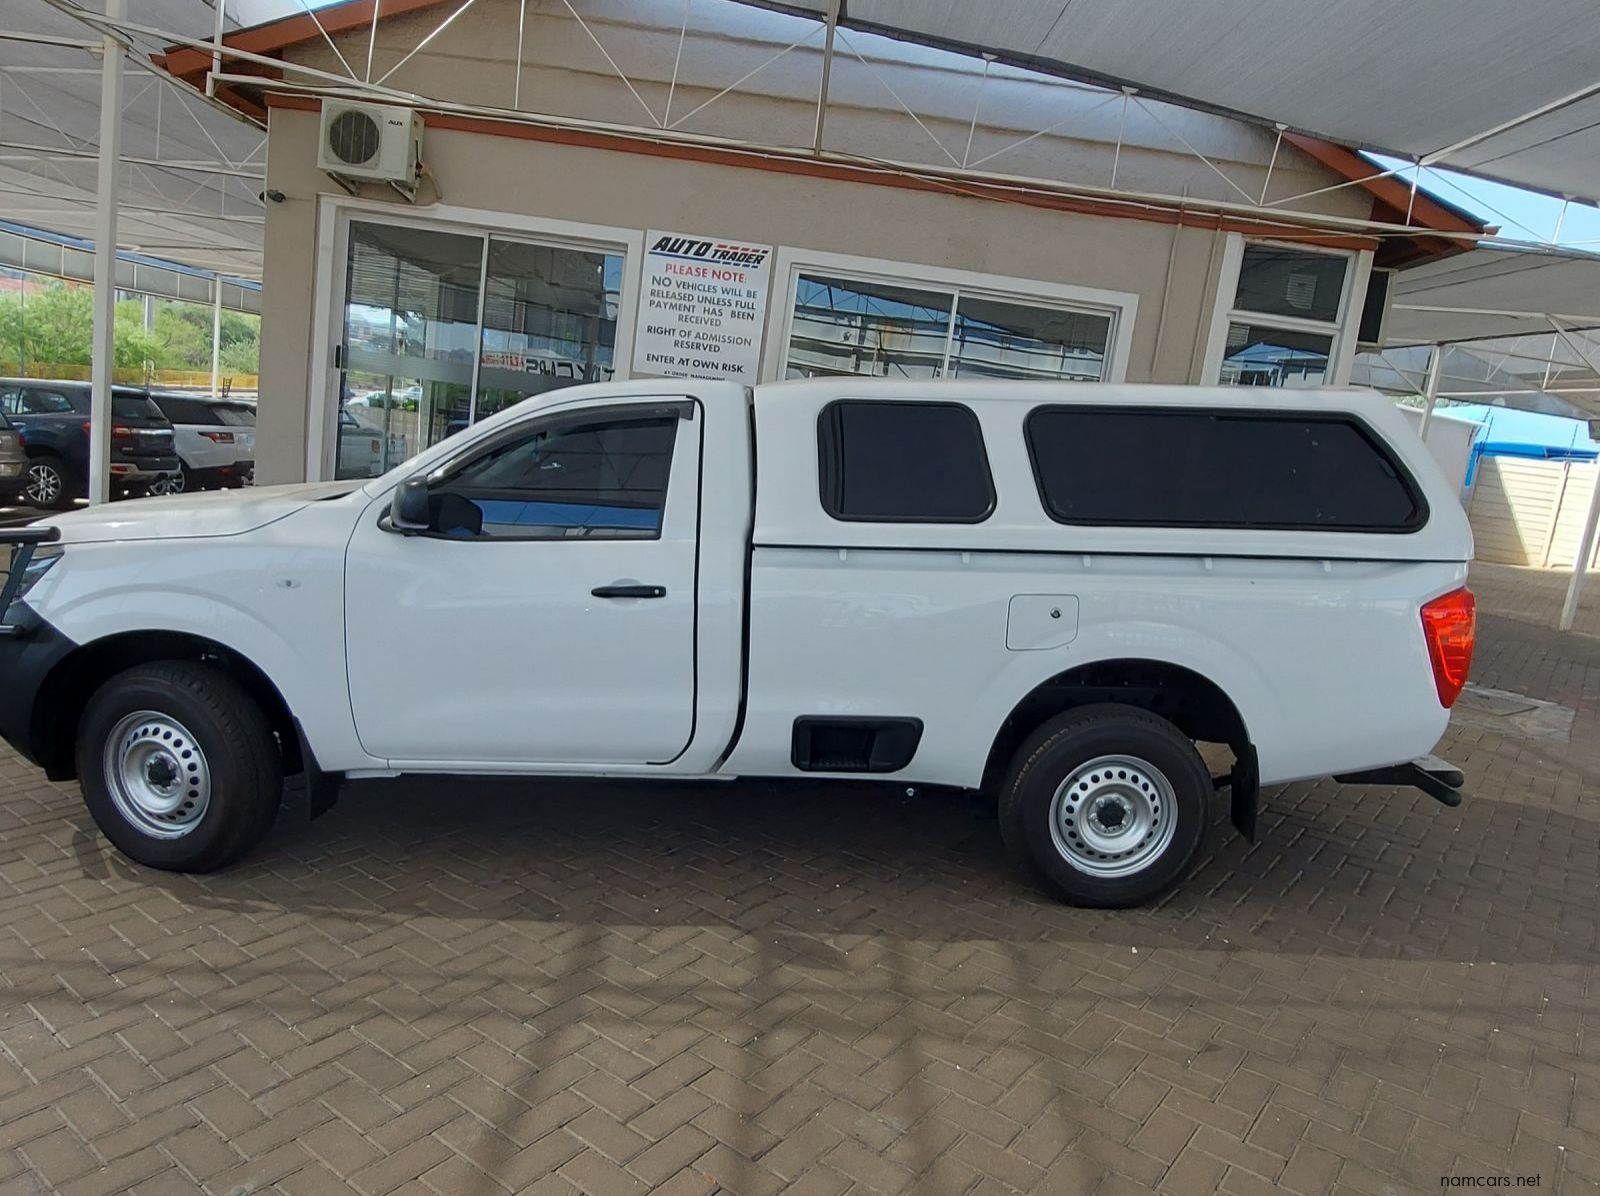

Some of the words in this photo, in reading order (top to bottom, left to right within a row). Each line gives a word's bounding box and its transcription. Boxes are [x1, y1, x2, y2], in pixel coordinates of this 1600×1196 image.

[652, 236, 713, 257] AUTO
[711, 249, 764, 265] TRADER
[665, 263, 708, 278] PLEASE
[651, 275, 672, 287] NO
[676, 279, 718, 294] VEHICLES
[721, 286, 743, 297] WILL
[746, 289, 758, 299] BE
[650, 289, 694, 302] RELEASED
[697, 295, 733, 307] UNLESS
[735, 300, 756, 310] FULL
[649, 300, 697, 314] PAYMENT
[703, 306, 723, 317] HAS
[730, 310, 755, 321] BEEN
[678, 314, 722, 327] RECEIVED
[646, 325, 677, 337] RIGHT
[678, 329, 692, 338] OF
[694, 332, 752, 346] ADMISSION
[673, 339, 721, 353] RESERVED
[646, 353, 676, 365] ENTER
[678, 357, 690, 366] AT
[692, 359, 719, 370] OWN
